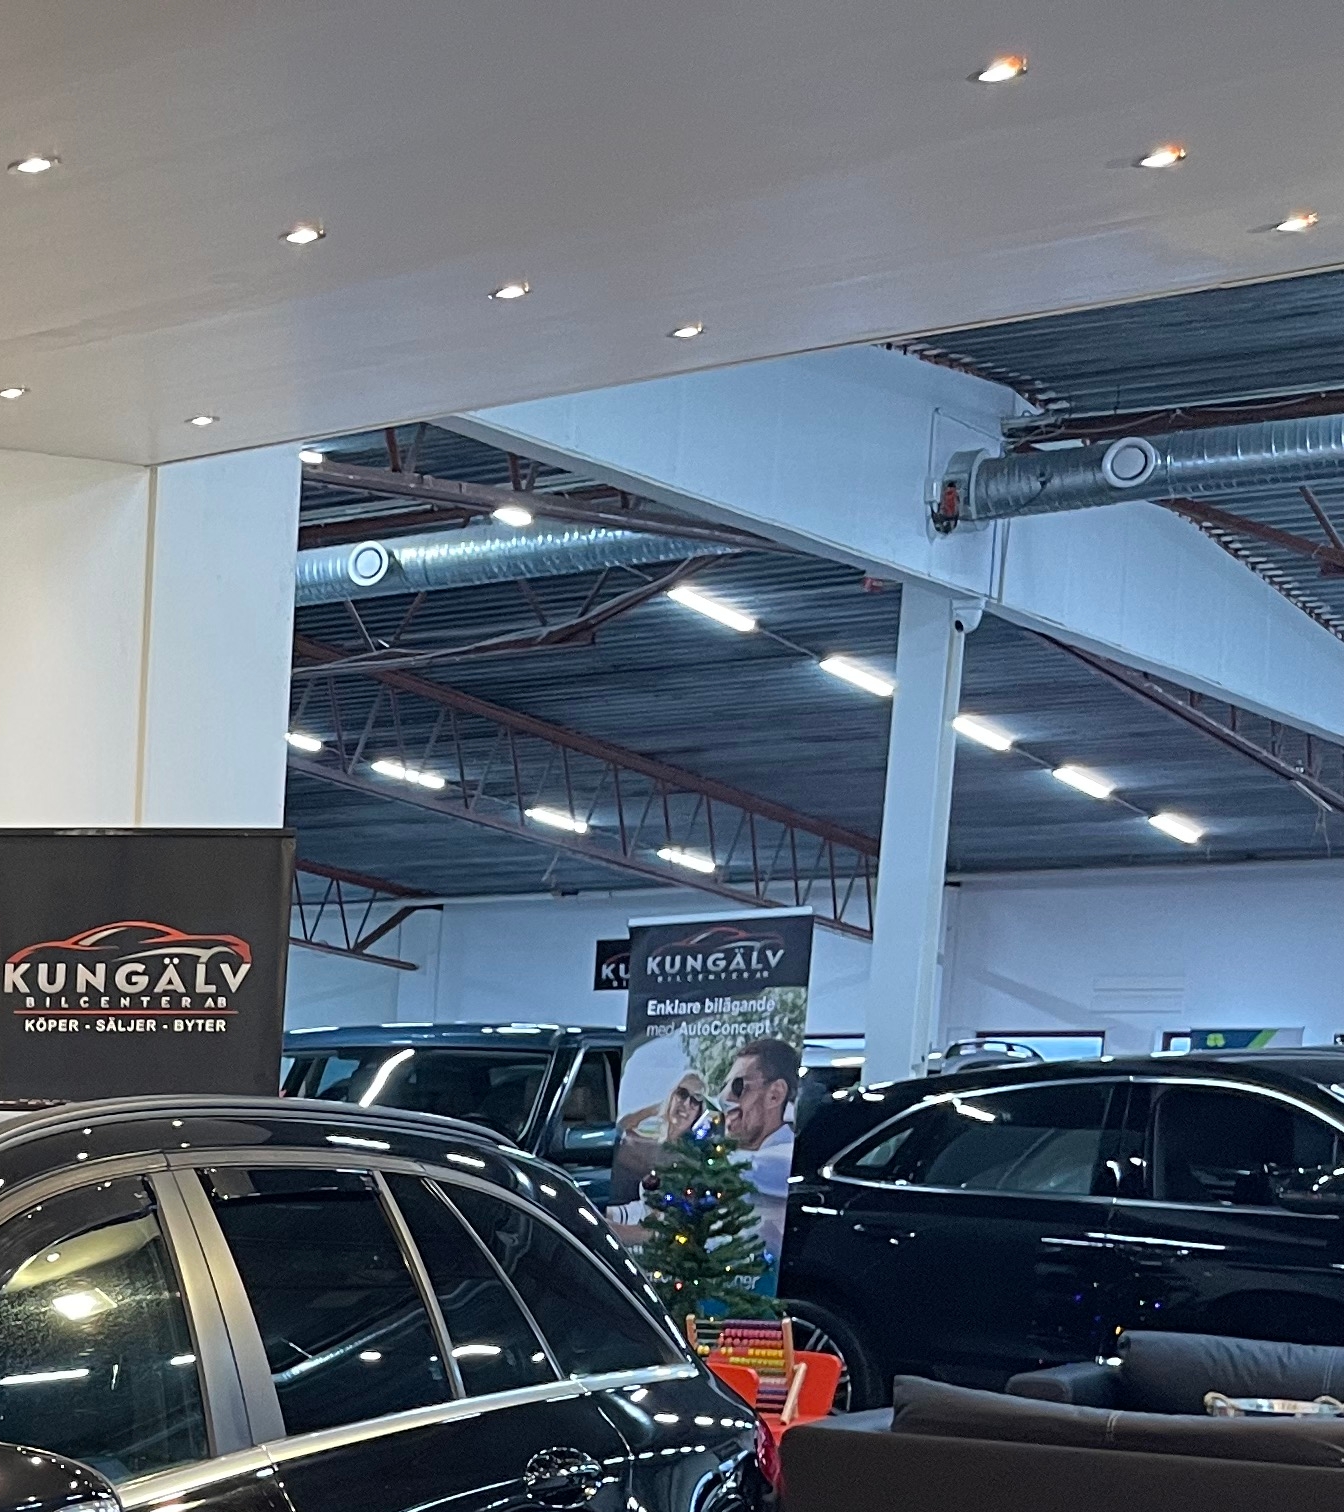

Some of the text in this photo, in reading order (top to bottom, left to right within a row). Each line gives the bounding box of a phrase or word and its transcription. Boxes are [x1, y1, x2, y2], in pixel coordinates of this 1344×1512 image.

[646, 948, 785, 976] KUNGÄLV
[3, 958, 252, 994] KUNGÄLV
[25, 996, 228, 1009] BILCENTER AB
[646, 995, 776, 1017] Enklare bilägande
[24, 1016, 80, 1033] KÖPER
[95, 1016, 157, 1033] SÄLJER
[173, 1018, 227, 1033] BYTER
[646, 1018, 772, 1038] med AutoConcept
